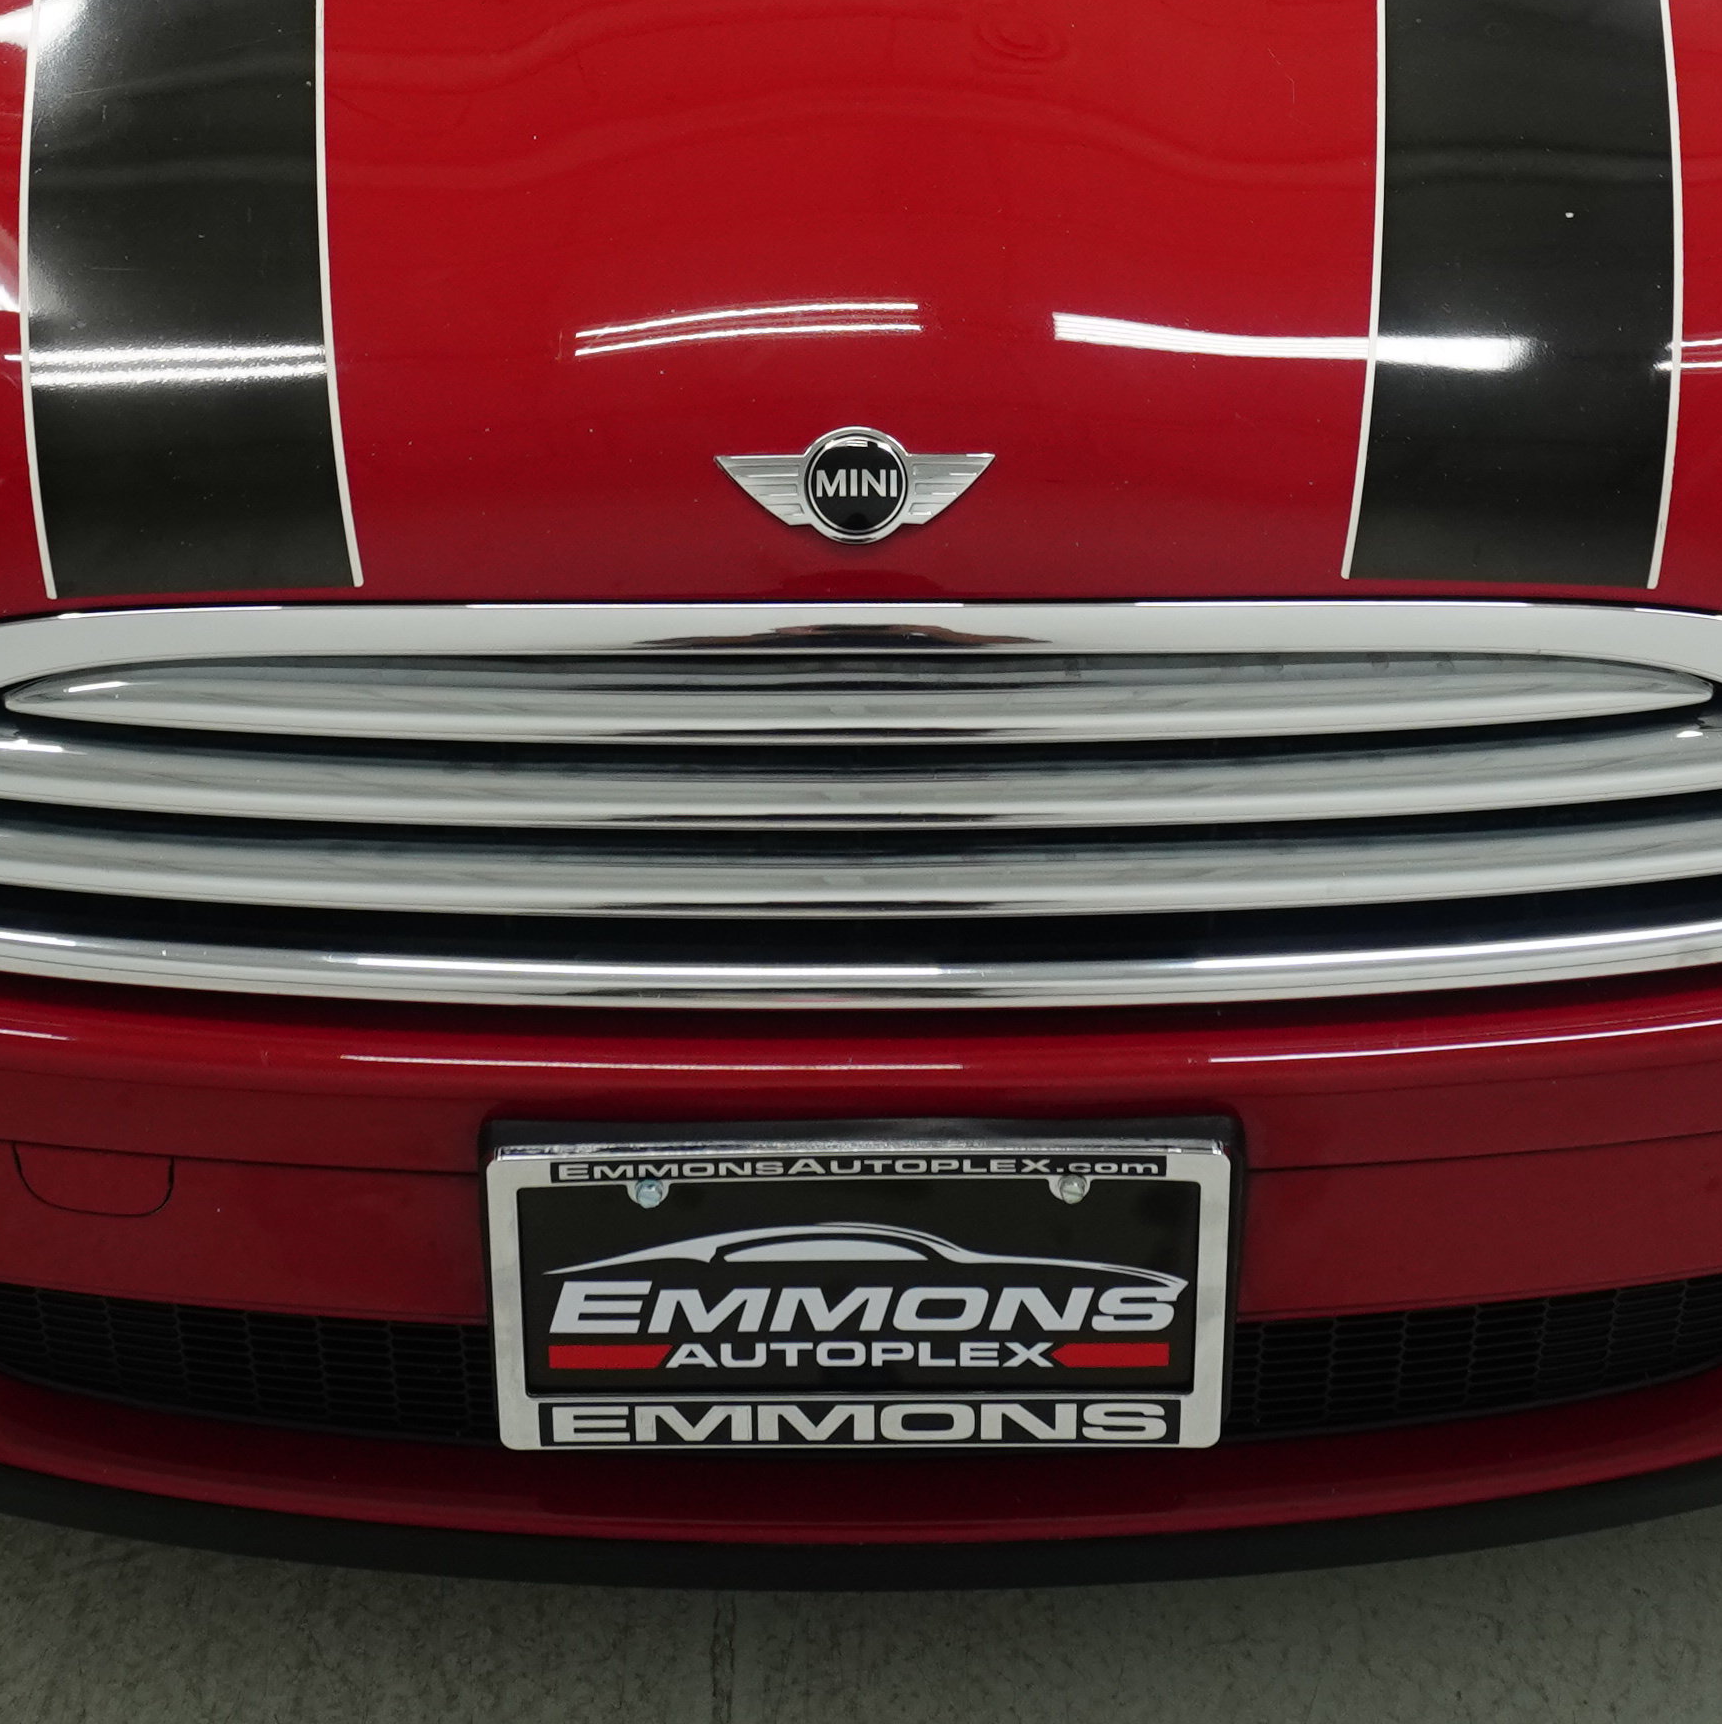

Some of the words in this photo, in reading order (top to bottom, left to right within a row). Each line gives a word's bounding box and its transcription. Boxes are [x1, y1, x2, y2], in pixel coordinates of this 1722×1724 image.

[815, 468, 898, 498] MINI
[549, 1280, 1177, 1335] EMMONS
[665, 1340, 1055, 1368] AUTOPLEX
[551, 1402, 1168, 1443] EMMONS
